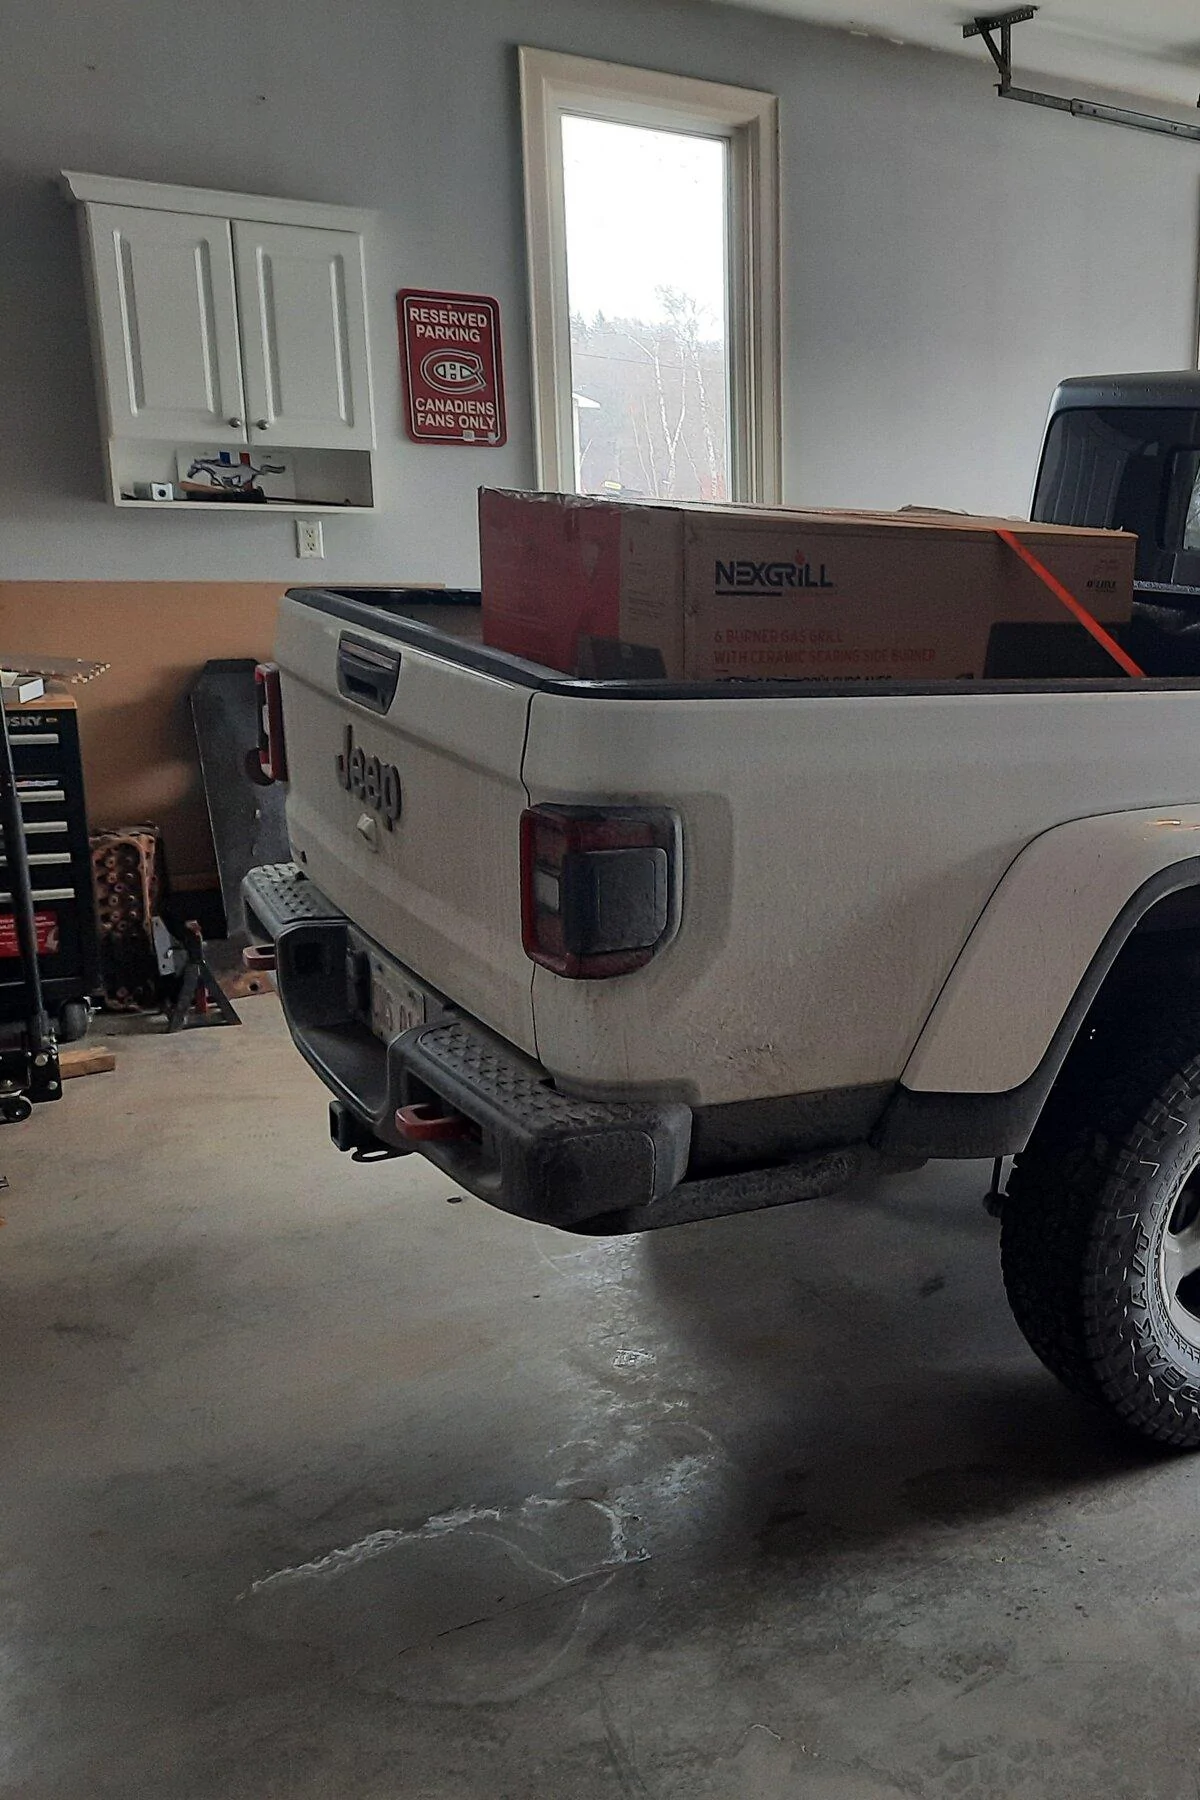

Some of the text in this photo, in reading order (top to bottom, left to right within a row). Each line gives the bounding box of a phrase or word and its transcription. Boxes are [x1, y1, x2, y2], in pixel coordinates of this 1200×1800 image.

[409, 307, 488, 328] RESERVED
[415, 324, 481, 343] PARKING
[415, 397, 495, 416] CANADIENS
[417, 412, 496, 430] FANS ONLY
[715, 553, 834, 588] NEXGRILL
[726, 629, 779, 643] BURNER
[713, 650, 749, 664] WITH
[337, 723, 403, 832] Jeep
